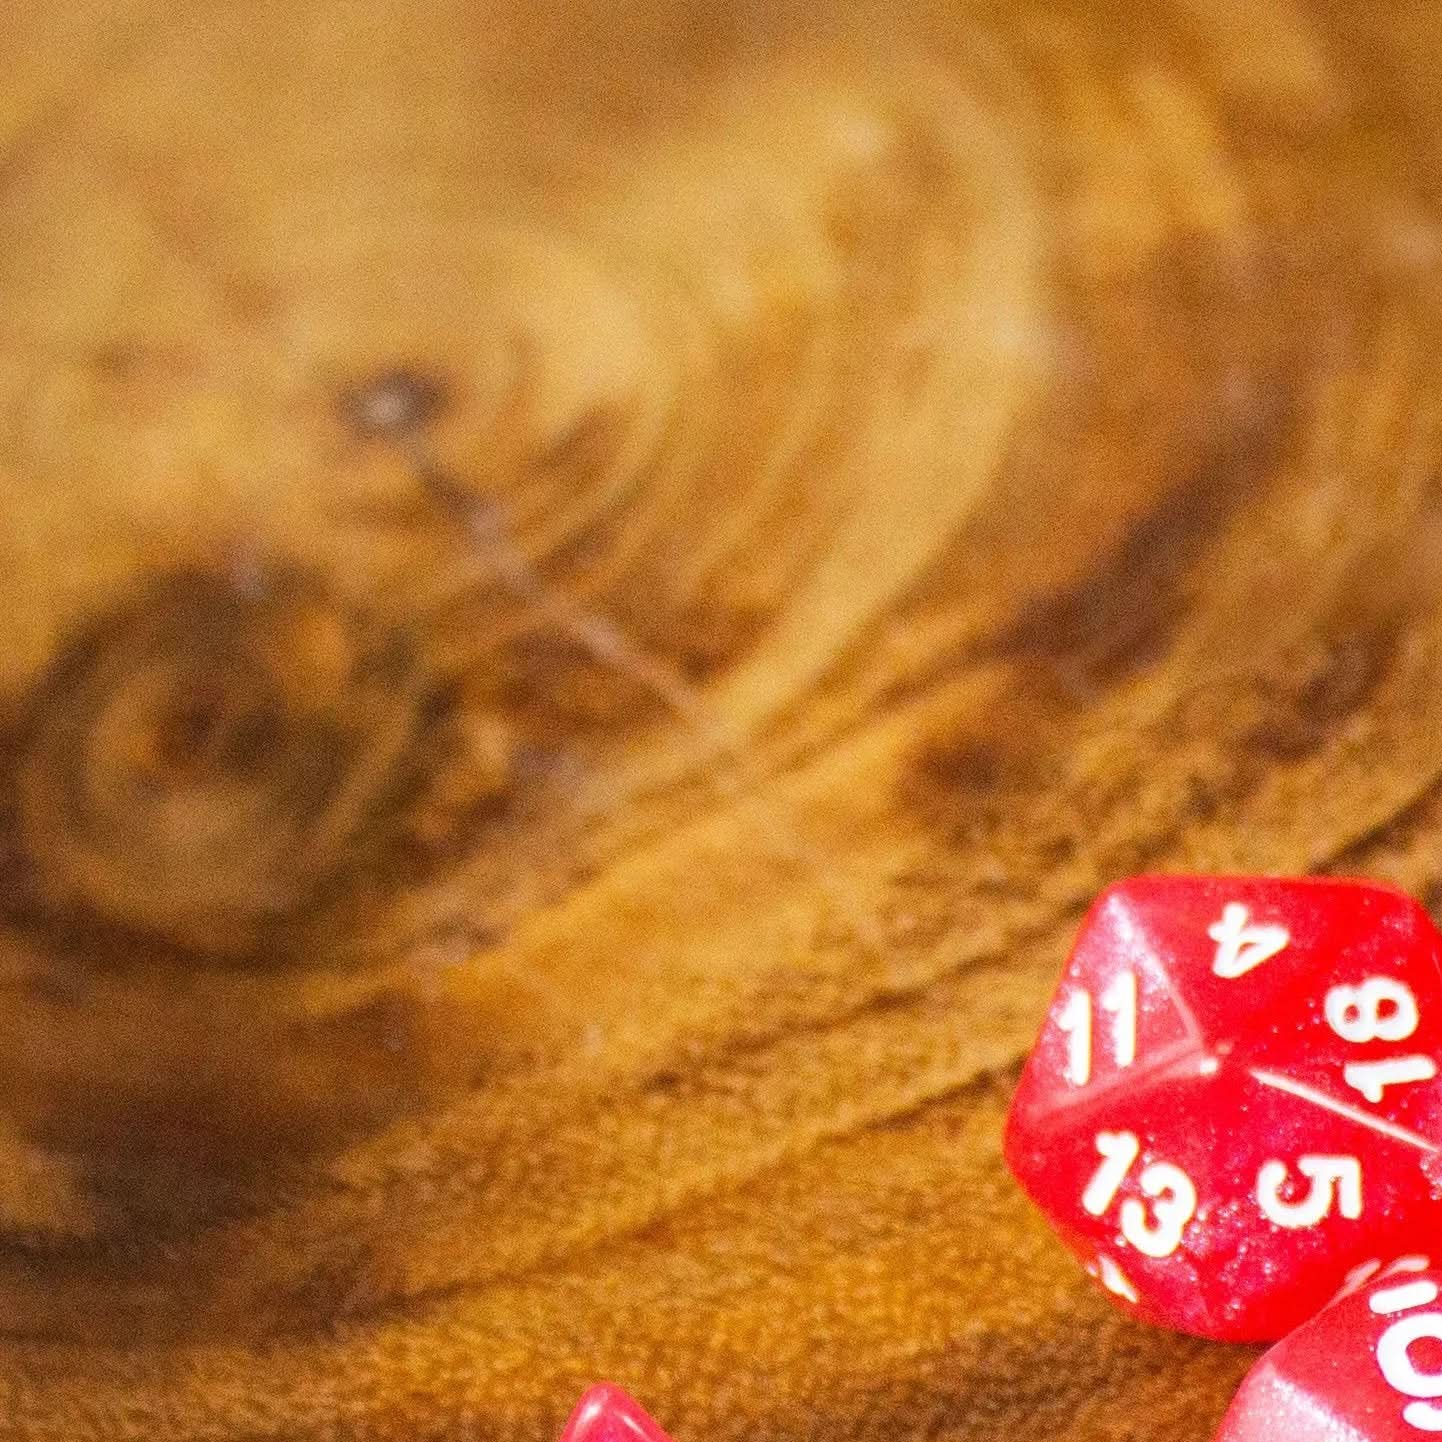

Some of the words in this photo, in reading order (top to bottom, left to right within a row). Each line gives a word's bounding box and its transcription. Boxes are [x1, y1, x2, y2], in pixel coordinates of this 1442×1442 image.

[1208, 903, 1289, 978] 4
[1057, 973, 1136, 1086] 11
[1324, 977, 1435, 1102] 18
[1083, 1132, 1195, 1257] 13
[1257, 1157, 1362, 1229] 5
